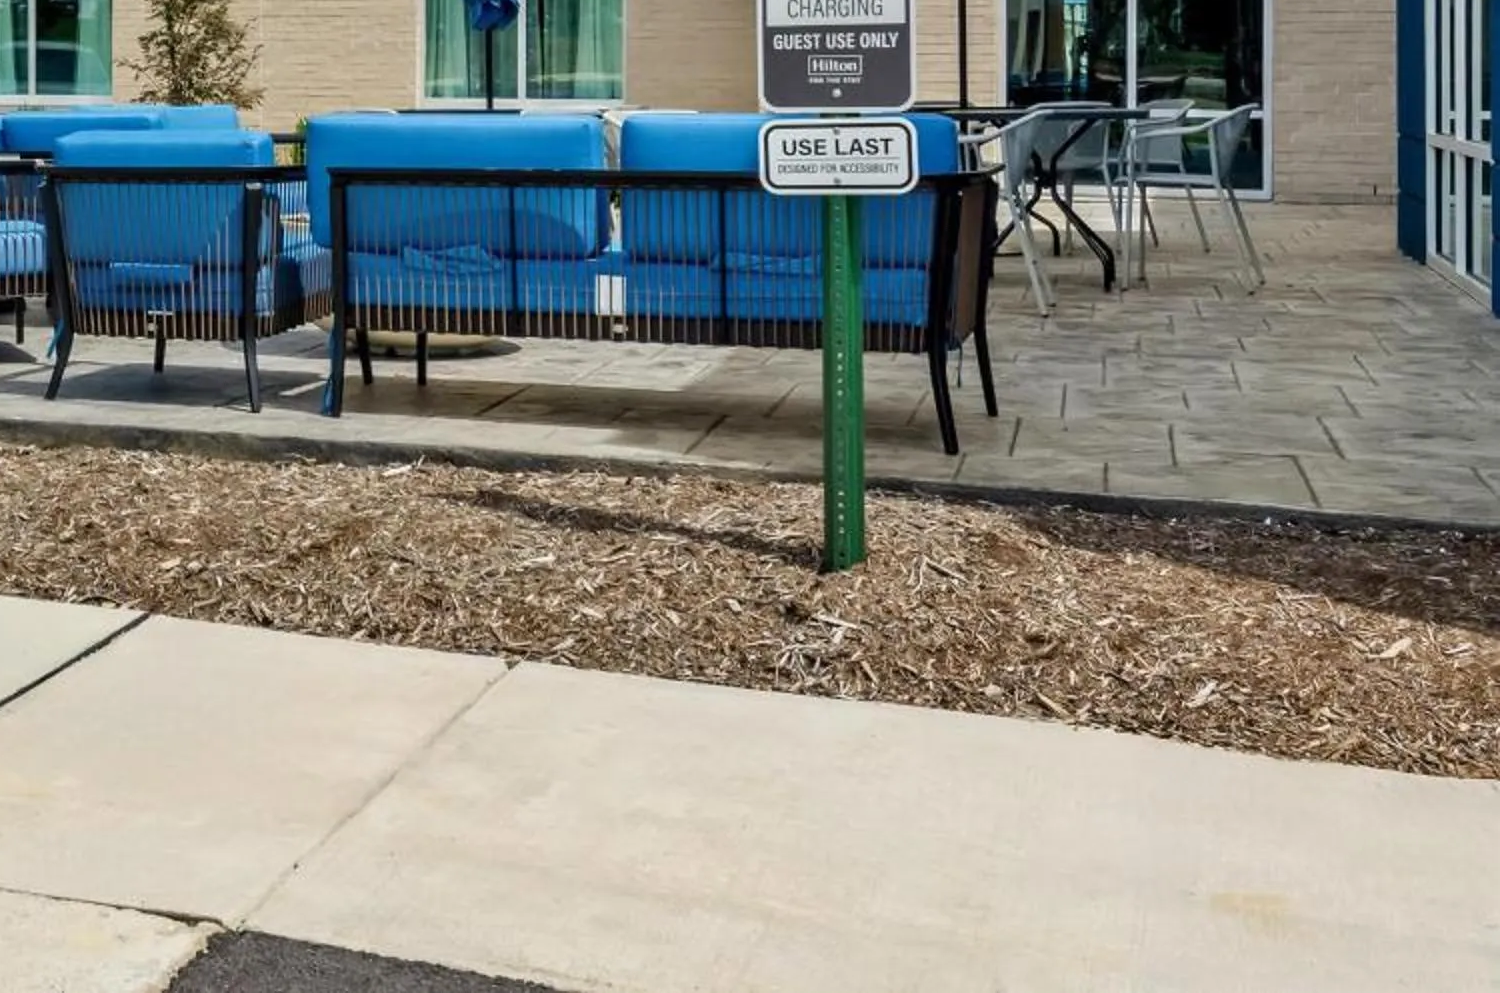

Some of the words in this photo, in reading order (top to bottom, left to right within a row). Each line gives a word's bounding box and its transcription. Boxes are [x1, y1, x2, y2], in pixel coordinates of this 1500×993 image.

[773, 34, 821, 50] GUEST
[826, 33, 855, 49] USE
[860, 32, 899, 48] ONLY
[812, 58, 857, 72] Hilton
[782, 138, 827, 156] USE
[835, 138, 893, 156] LAST
[778, 163, 818, 174] DESIGNED
[820, 163, 837, 174] FOR
[840, 162, 899, 174] ACCESSIBILITY
